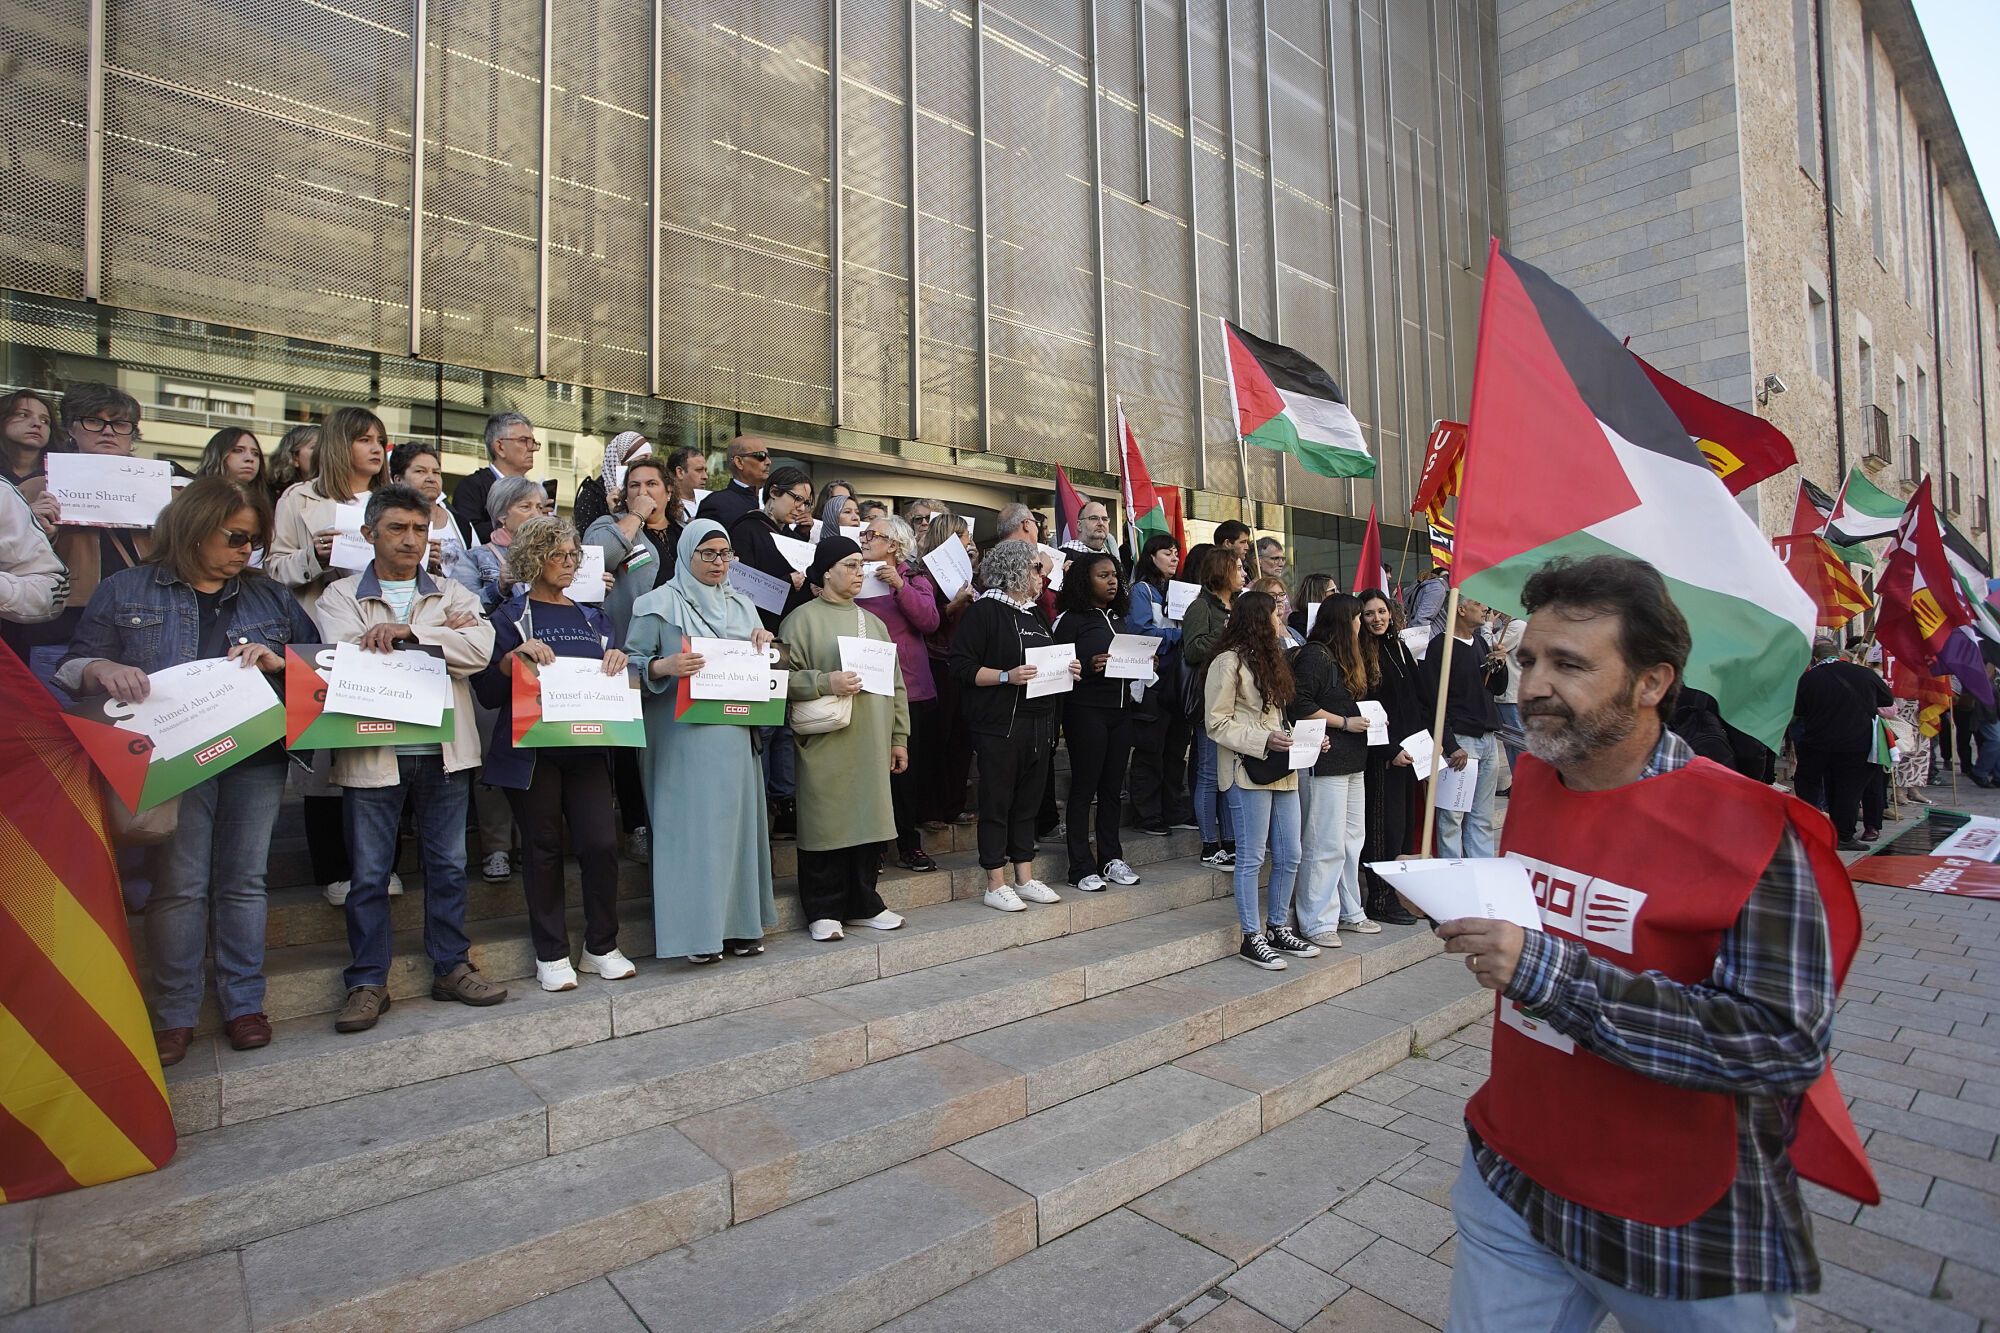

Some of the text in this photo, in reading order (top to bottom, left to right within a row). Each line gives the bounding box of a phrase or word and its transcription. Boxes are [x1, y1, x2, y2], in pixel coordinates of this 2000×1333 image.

[58, 488, 137, 503] Nour Sharaf
[534, 627, 565, 637] WEAT
[695, 671, 760, 682] Jameel Abu Asi
[338, 679, 413, 701] Rimas Zarab
[548, 691, 624, 702] Yousef al-Zaanin
[153, 682, 235, 727] Ahmed Abu Layla
[359, 723, 395, 733] CCOO
[573, 725, 602, 733] CCOO
[197, 738, 236, 764] CCOO
